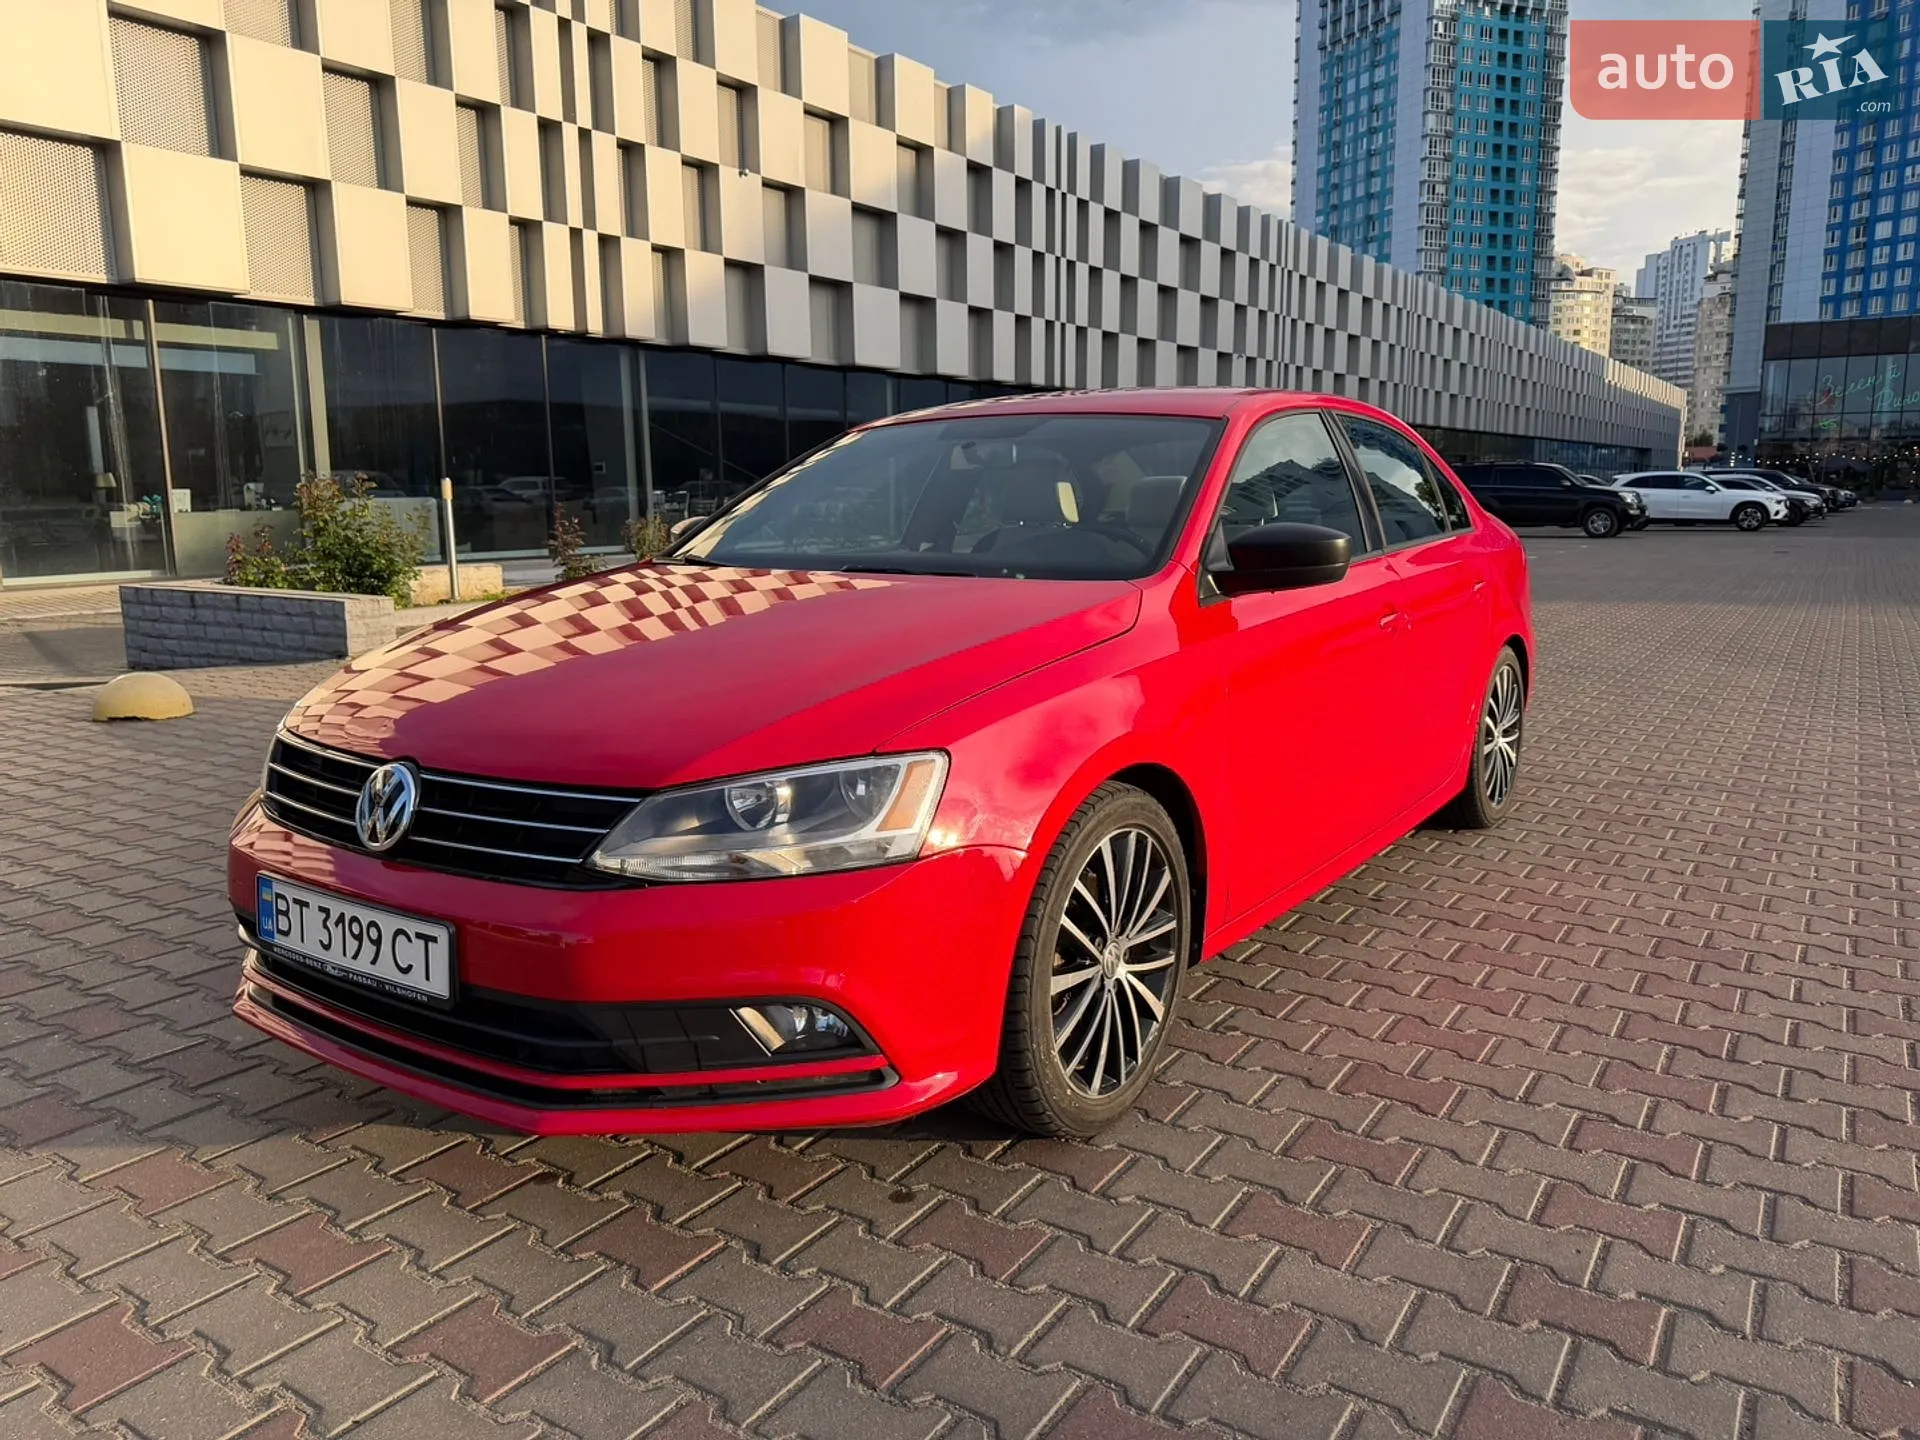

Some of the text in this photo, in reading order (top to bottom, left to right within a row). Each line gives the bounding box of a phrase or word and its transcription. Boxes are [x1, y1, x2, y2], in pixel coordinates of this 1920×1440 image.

[262, 918, 274, 932] UA
[275, 892, 439, 981] BT 3199 CT
[348, 972, 377, 987] PASSAU
